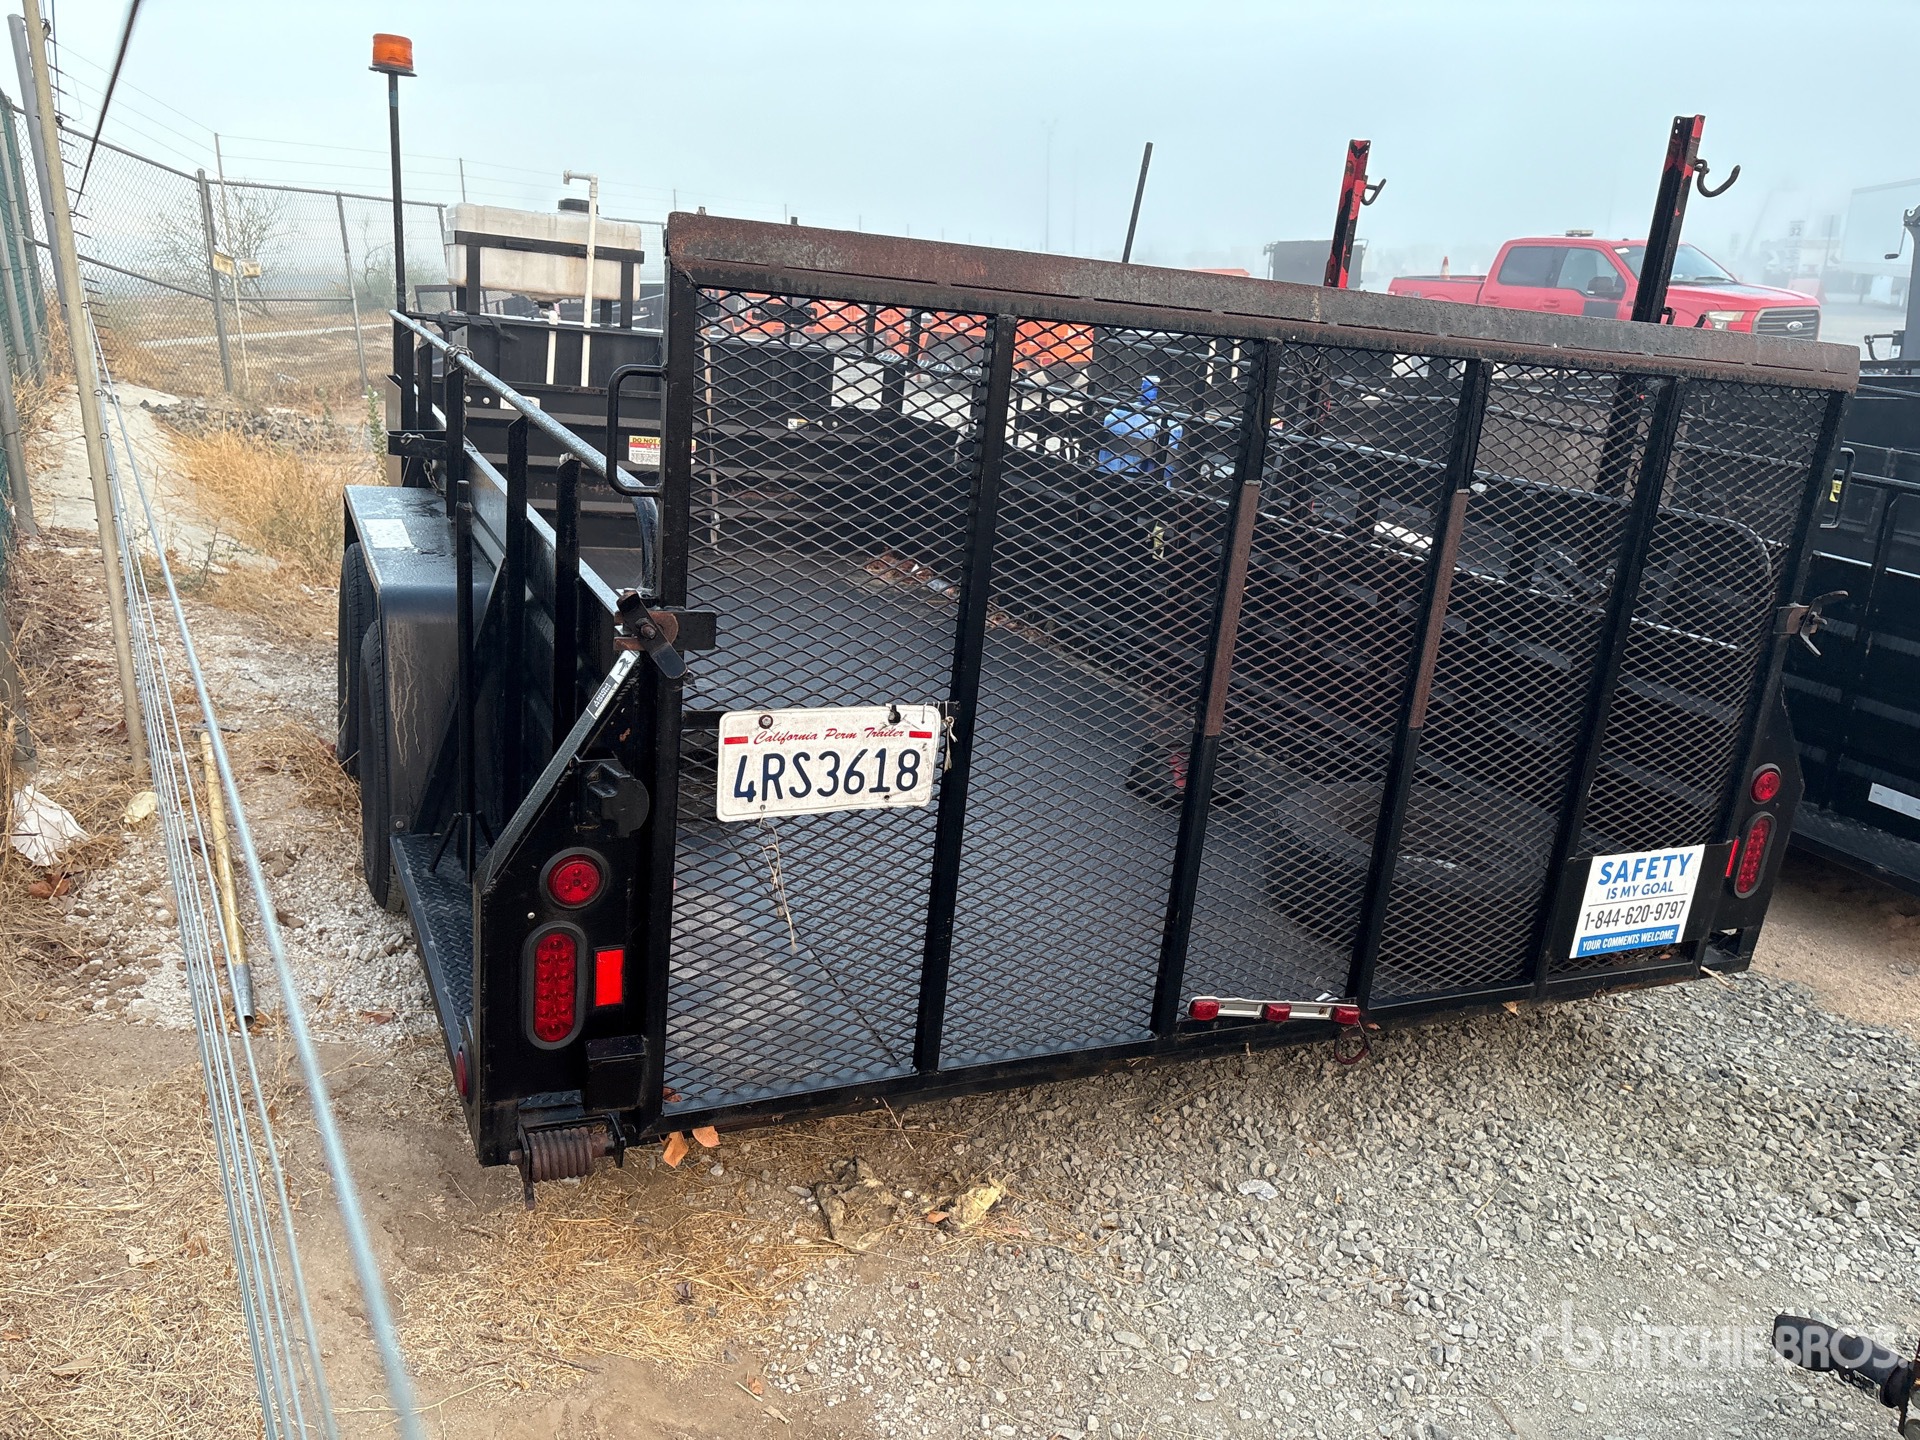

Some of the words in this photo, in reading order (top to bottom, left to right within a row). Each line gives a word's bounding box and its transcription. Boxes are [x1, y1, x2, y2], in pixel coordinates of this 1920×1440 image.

[753, 730, 818, 746] California
[823, 728, 858, 740] Perm
[863, 726, 905, 740] Trailer
[733, 747, 921, 803] 4RS3618
[1597, 852, 1694, 886] SAFETY
[1605, 888, 1618, 900] IS
[1619, 884, 1640, 899] MY
[1641, 881, 1674, 896] GOAL
[1584, 900, 1687, 931] 1-844-620-9797
[1582, 938, 1602, 952] YOUR
[1602, 933, 1641, 949] COMMENTS
[1640, 928, 1676, 943] WELCOME
